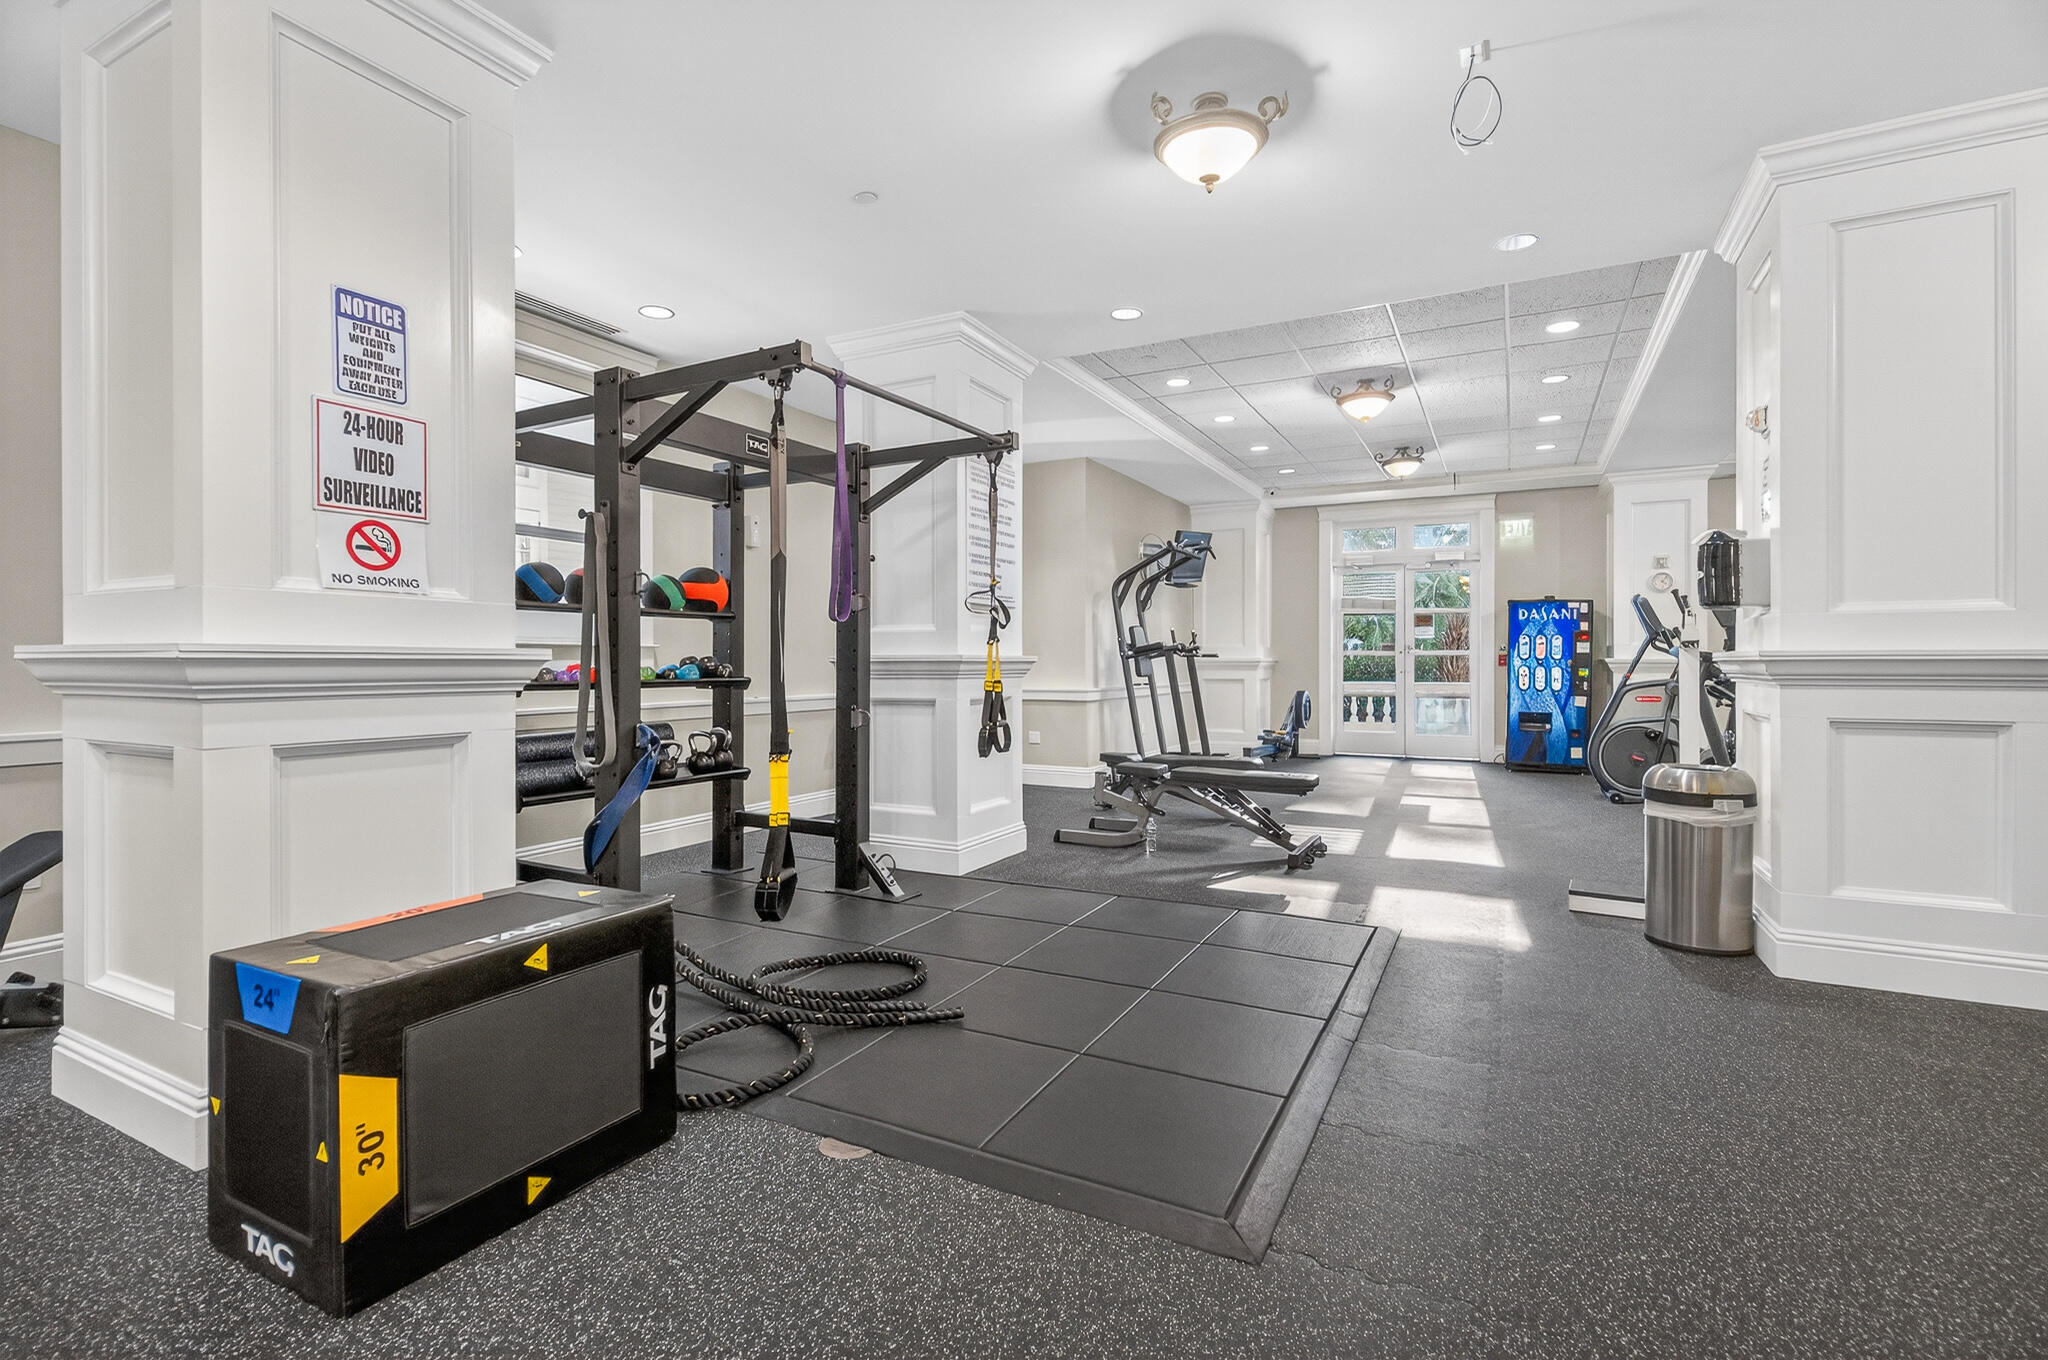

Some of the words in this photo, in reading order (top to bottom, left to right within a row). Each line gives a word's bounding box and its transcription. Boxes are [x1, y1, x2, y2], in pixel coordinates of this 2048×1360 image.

[340, 293, 403, 330] NOTICE
[348, 332, 396, 354] WEIGHTS
[352, 322, 372, 336] PUT
[374, 328, 391, 342] ALL
[343, 354, 401, 378] EQUIPMENT
[362, 347, 384, 361] AND
[342, 366, 372, 382] AWAY
[373, 374, 403, 390] AFTER
[348, 380, 376, 395] EACH
[377, 386, 397, 400] USE
[343, 410, 404, 446] 24-HOUR
[353, 447, 394, 477] VIDEO
[323, 476, 422, 514] SURVEILLANCE
[331, 573, 353, 585] NO
[357, 575, 420, 590] SMOKING
[1518, 606, 1577, 622] DASANI
[253, 983, 281, 1011] 24"
[648, 984, 668, 1070] TAG
[355, 1123, 385, 1177] 30"
[240, 1223, 295, 1278] TAG
